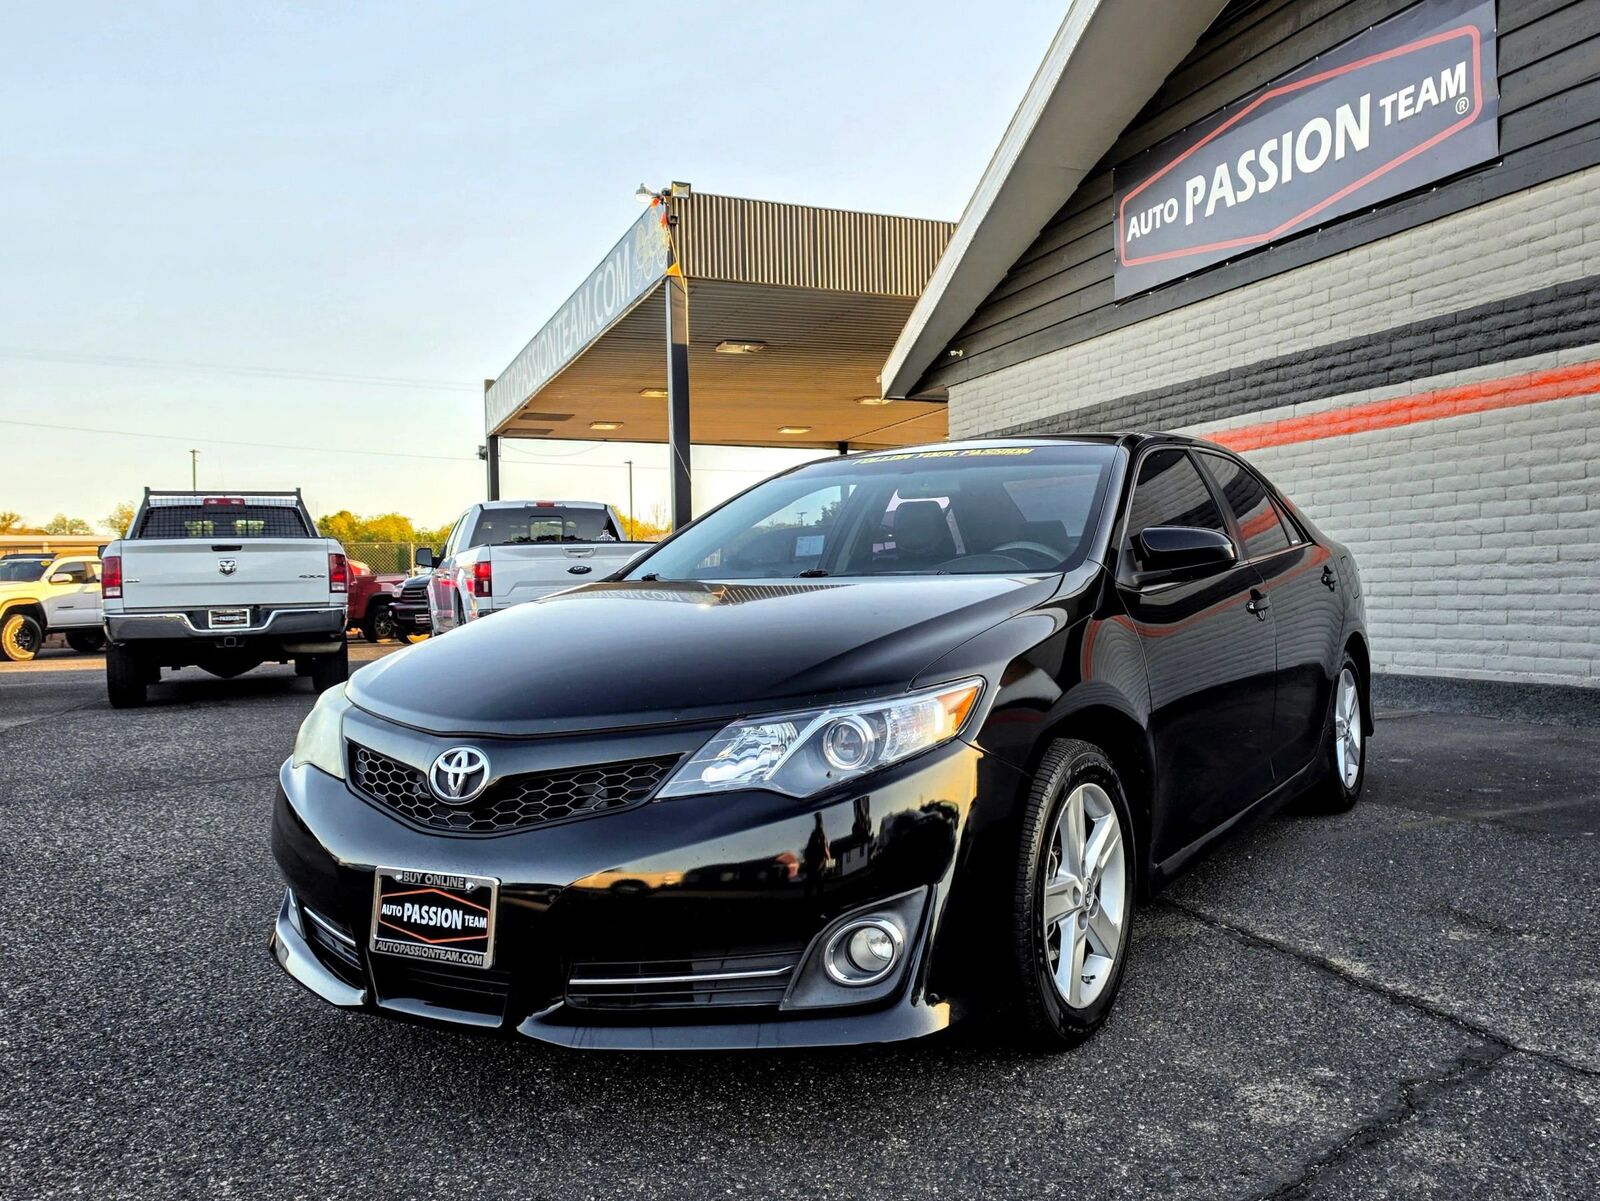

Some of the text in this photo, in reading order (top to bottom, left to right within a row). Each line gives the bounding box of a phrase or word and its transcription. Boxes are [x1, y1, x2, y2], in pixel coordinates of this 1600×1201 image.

[1126, 61, 1467, 242] AUTO PASSION TEAM
[497, 243, 629, 419] AUTOPASSIONTEAM.COM
[403, 872, 465, 888] BUY ONLINE
[381, 903, 487, 929] AUTO PASSION TEAM
[376, 941, 482, 965] AUTOPASSIONTEAM.COM
